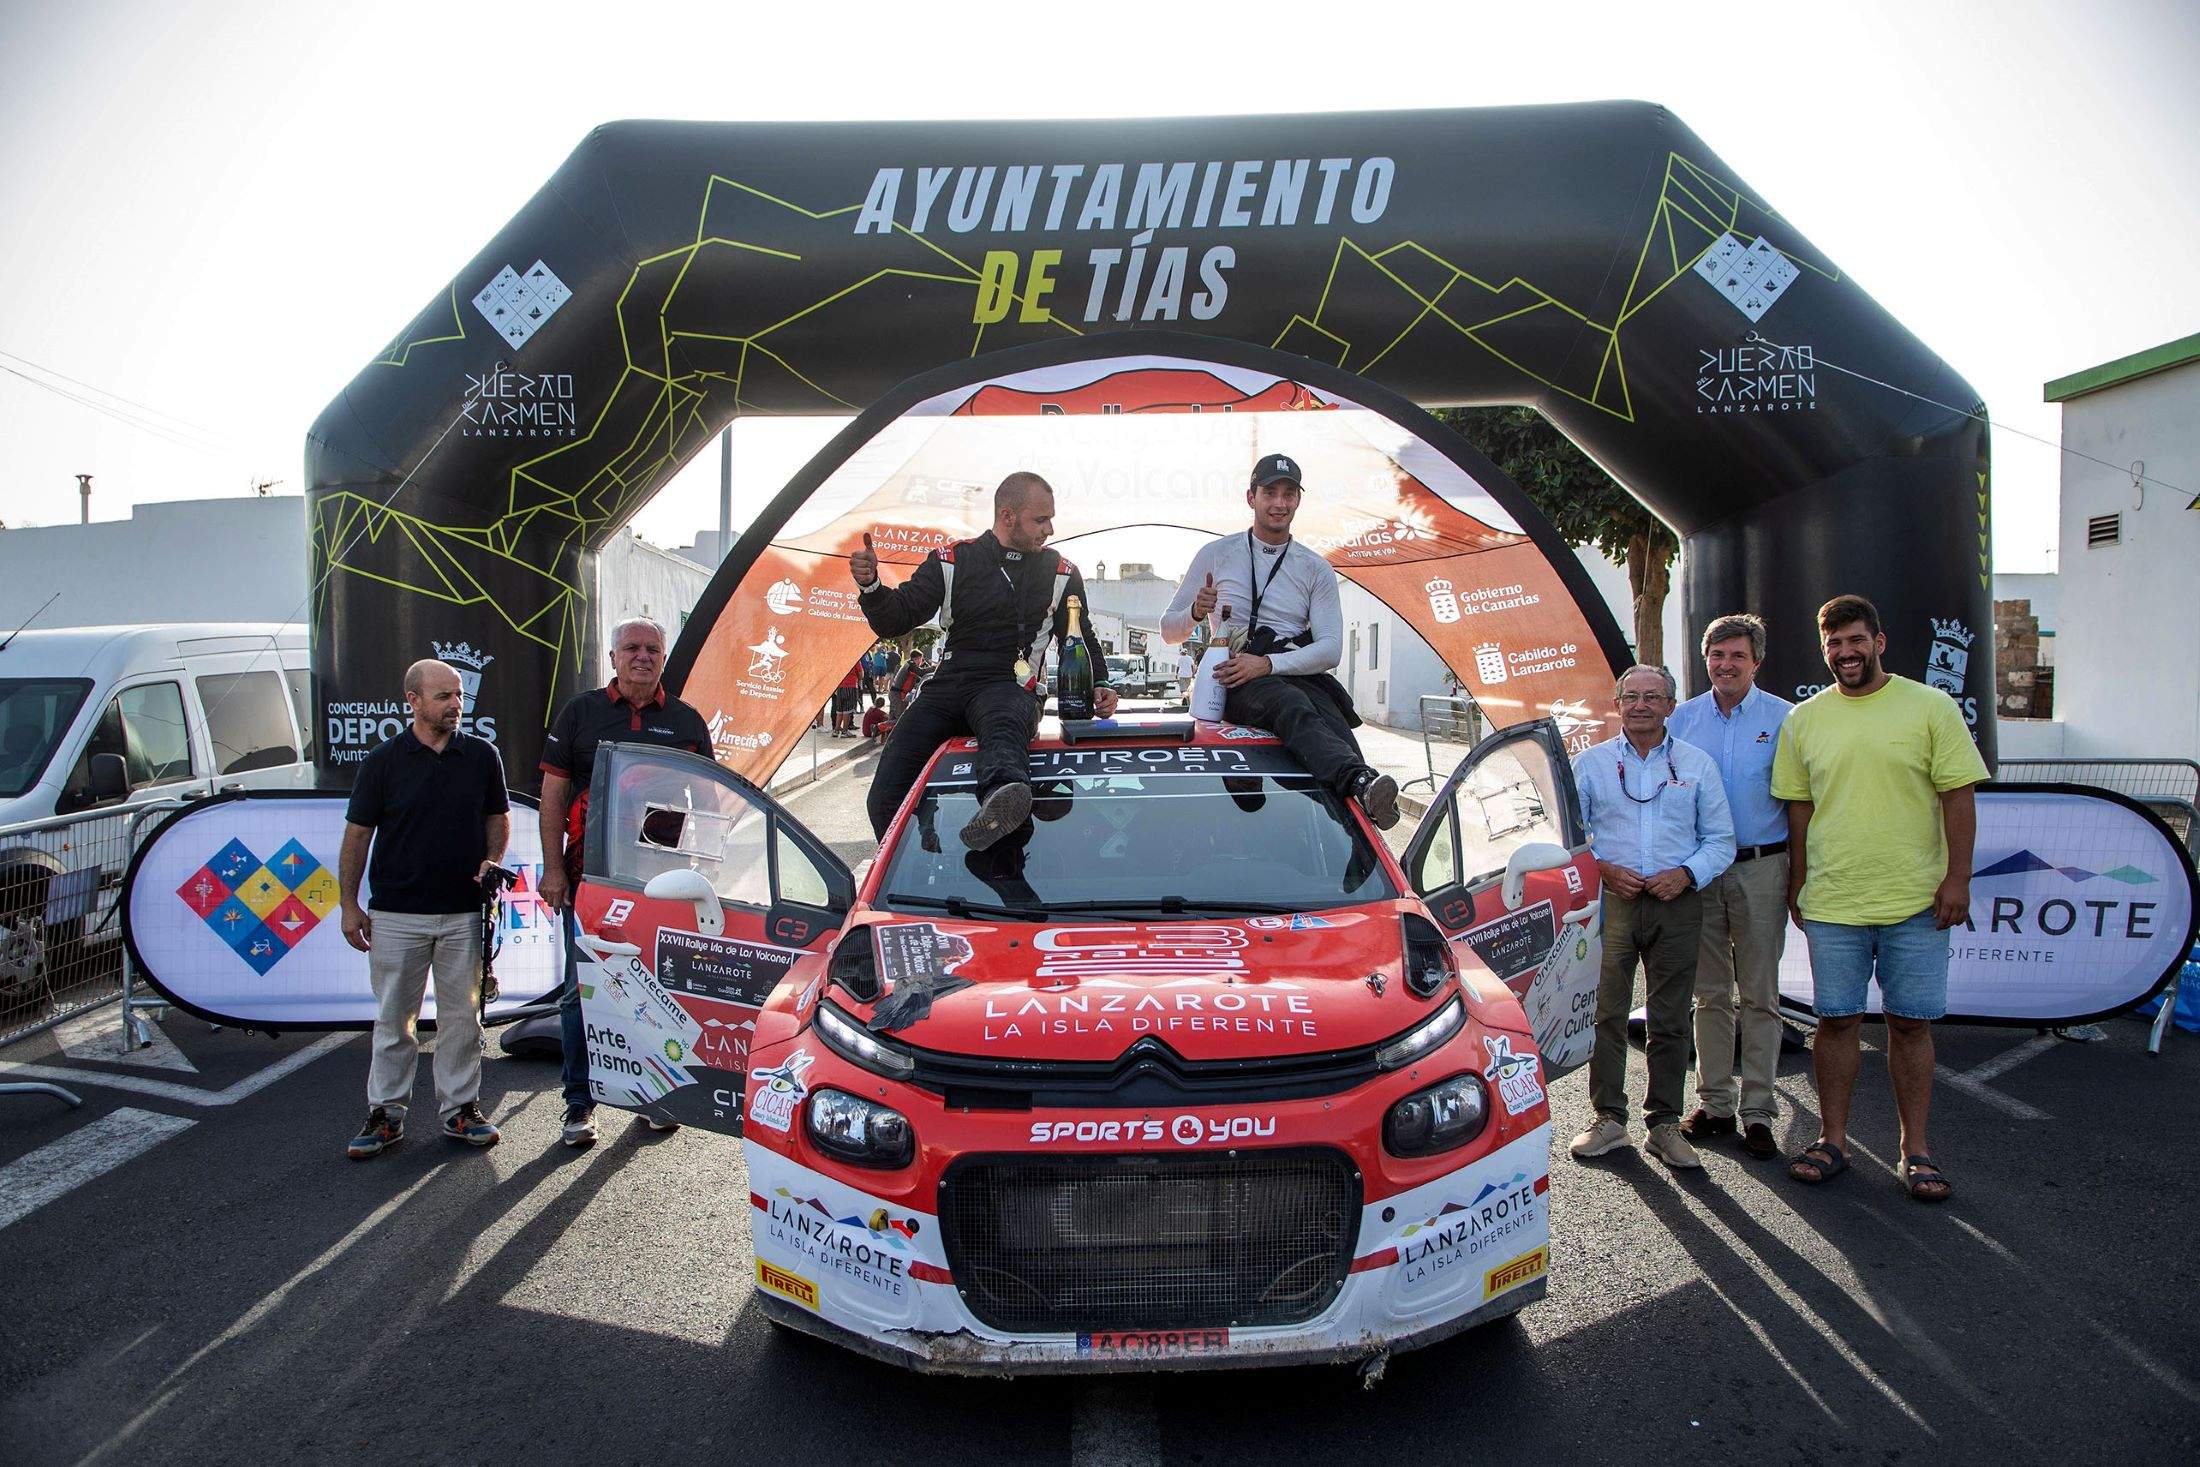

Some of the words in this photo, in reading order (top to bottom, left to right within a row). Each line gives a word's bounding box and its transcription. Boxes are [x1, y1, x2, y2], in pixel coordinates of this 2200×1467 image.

[853, 156, 1396, 234] AYUNTAMIENTO
[972, 249, 1063, 324] DE
[1082, 228, 1237, 322] TÍAS
[1698, 402, 1816, 413] LANZAROTE
[463, 428, 576, 436] LANZAROTE
[872, 541, 909, 552] SPORTS
[808, 597, 838, 608] Cultura
[811, 587, 843, 599] Centros
[845, 592, 857, 600] de
[1460, 583, 1523, 603] Gobierno
[1463, 602, 1480, 616] de
[1482, 593, 1540, 613] Canarias
[808, 609, 832, 618] Cabildo
[1508, 644, 1557, 664] Cabildo
[1560, 642, 1577, 655] de
[1511, 656, 1576, 677] Lanzarote
[736, 680, 761, 690] Servicio
[763, 683, 785, 694] Insular
[740, 688, 749, 696] de
[749, 689, 778, 700] Deportes
[328, 699, 400, 717] CONCEJALÍA
[719, 728, 759, 748] Arrecife
[1056, 764, 1251, 775] ACING
[660, 933, 684, 947] XXVII
[684, 937, 709, 952] Rallye
[710, 942, 723, 953] Isla
[725, 946, 737, 956] de
[740, 947, 753, 958] Los
[755, 949, 791, 965] Volcanes
[691, 961, 752, 980] LANZAROTE
[630, 958, 688, 1025] Orvecame
[984, 993, 1314, 1019] LANZAROTE
[587, 1023, 632, 1054] Arte,
[984, 1023, 1022, 1041] LA
[1041, 1018, 1113, 1036] ISLA
[1132, 1017, 1317, 1037] DIFERENTE
[589, 1050, 643, 1076] rismo
[706, 1056, 723, 1068] LA
[1501, 1073, 1539, 1102] CICAR
[755, 1089, 793, 1120] CICAR
[1029, 1120, 1165, 1142] SPORTS
[1174, 1117, 1201, 1142] &
[1405, 1185, 1532, 1265] LANZAROTE
[771, 1200, 903, 1278] LANZAROTE
[1407, 1266, 1426, 1283] LA
[1432, 1249, 1463, 1272] ISLA
[1470, 1209, 1535, 1255] DIFERENTE
[770, 1224, 785, 1239] LA
[790, 1233, 816, 1259] ISLA
[820, 1251, 902, 1296] DIFERENTE
[1490, 1251, 1543, 1293] PIRELLI
[761, 1264, 814, 1304] PIRELLI
